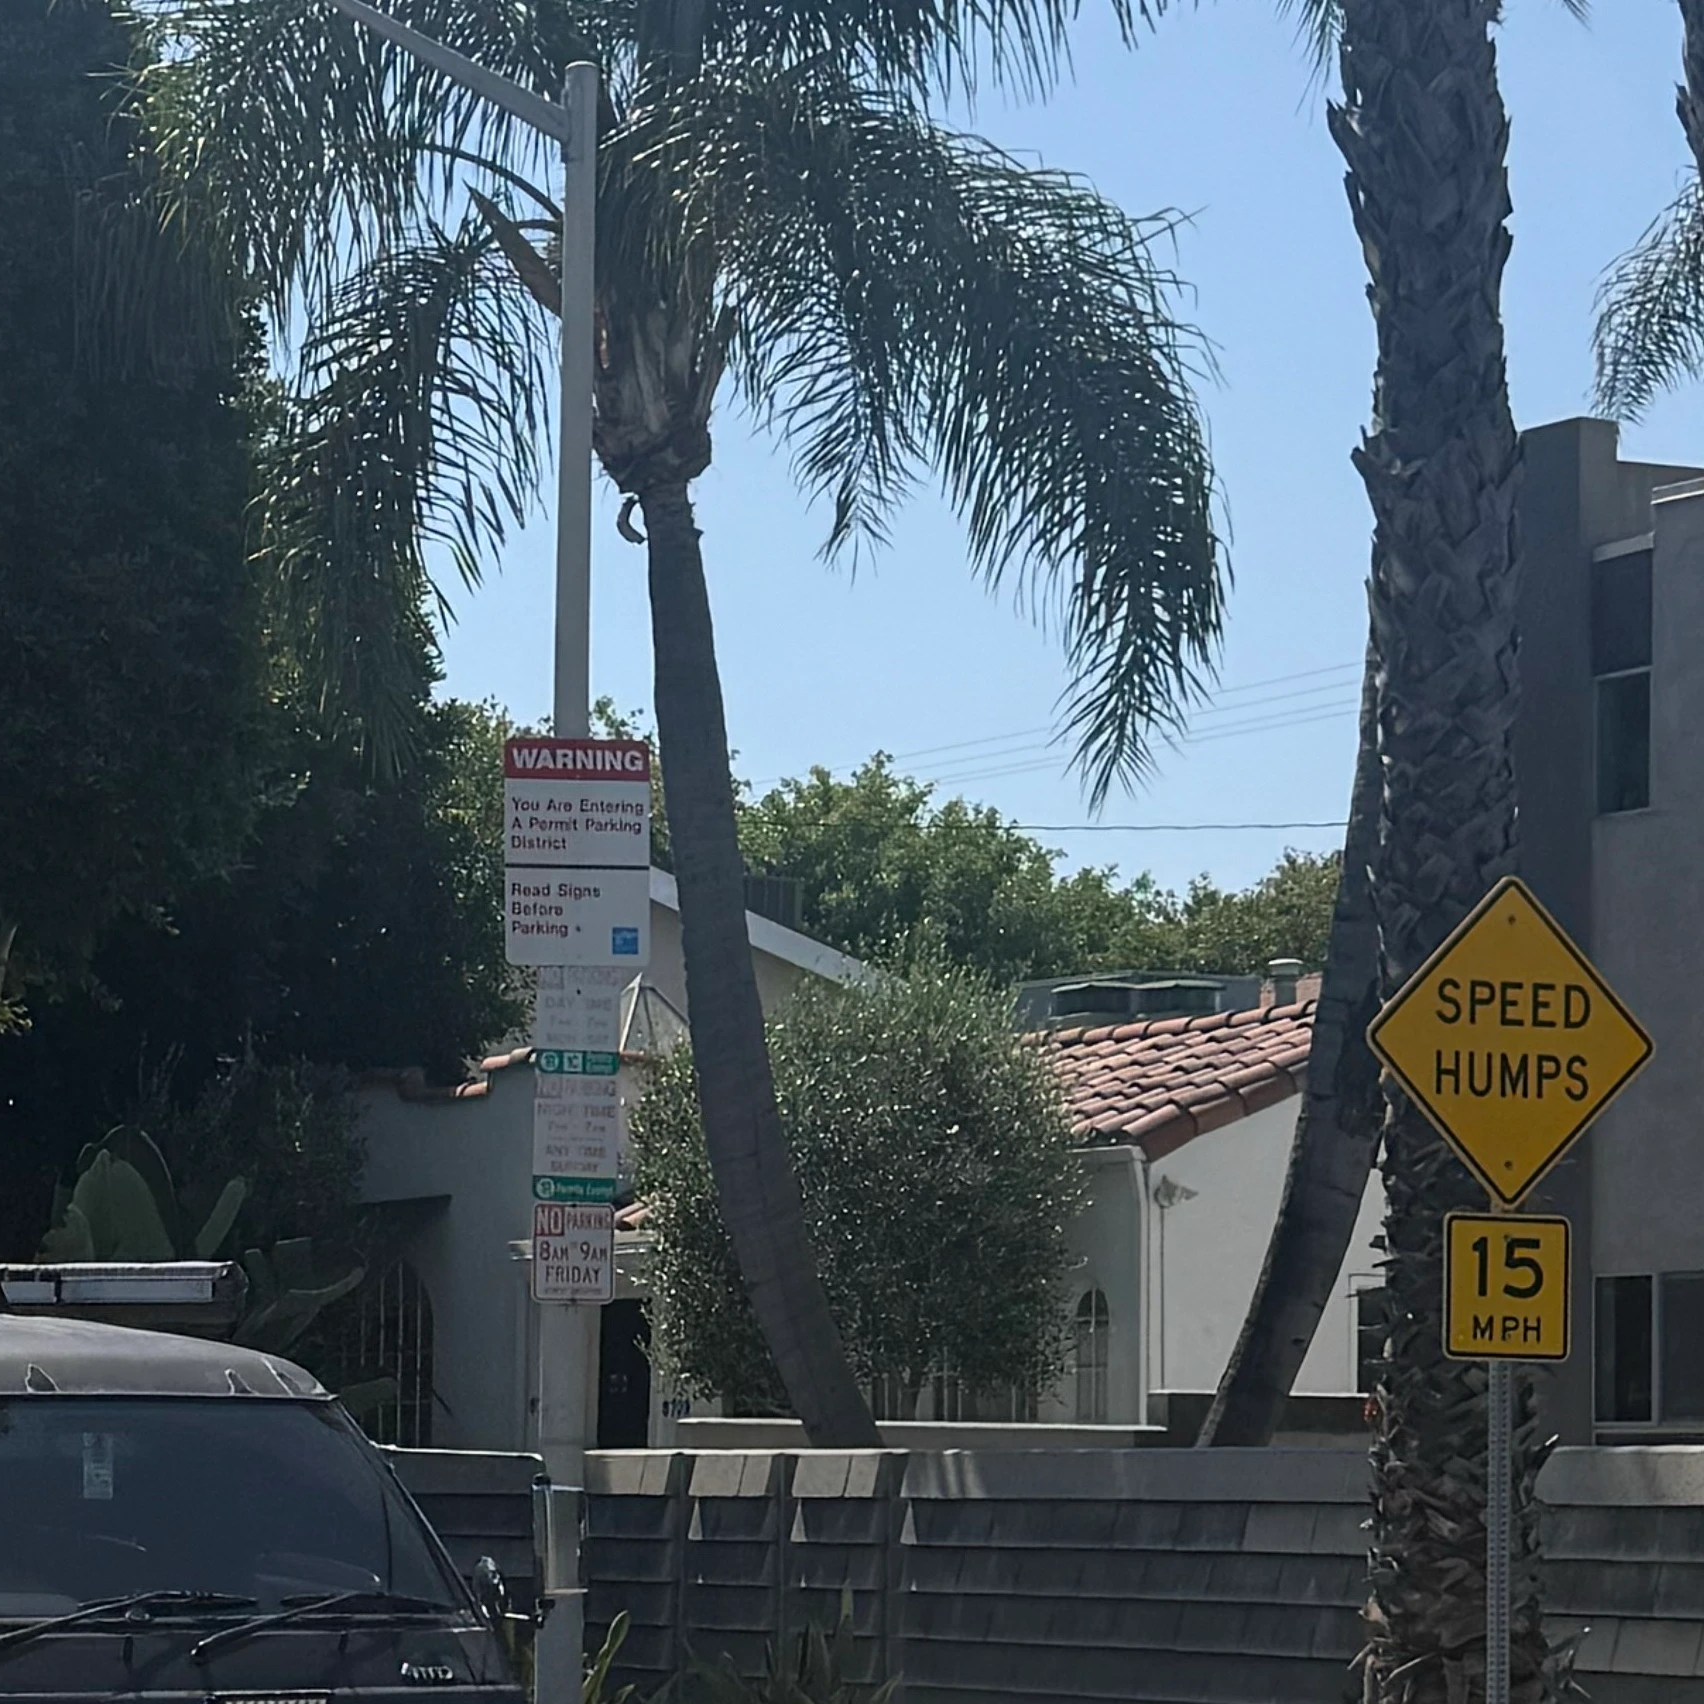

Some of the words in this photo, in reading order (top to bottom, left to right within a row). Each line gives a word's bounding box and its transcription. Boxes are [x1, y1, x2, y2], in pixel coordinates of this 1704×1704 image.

[512, 747, 644, 772] WARNING
[512, 797, 540, 812] You
[546, 799, 573, 812] Are
[579, 798, 644, 816] Entering
[511, 817, 523, 831] A
[529, 817, 578, 832] Permit
[585, 818, 642, 835] Parking
[511, 836, 567, 850] District
[511, 883, 550, 897] Read
[558, 884, 601, 900] Signs
[511, 902, 564, 917] Before
[511, 921, 569, 938] Parking
[1435, 977, 1591, 1030] SPEED
[1435, 1050, 1589, 1102] HUMPS
[537, 1207, 563, 1234] NO
[539, 1240, 570, 1261] 8AM
[579, 1241, 609, 1261] 9AM
[545, 1265, 602, 1285] FRIDAY
[1472, 1236, 1544, 1299] 15
[1473, 1315, 1541, 1343] MPH
